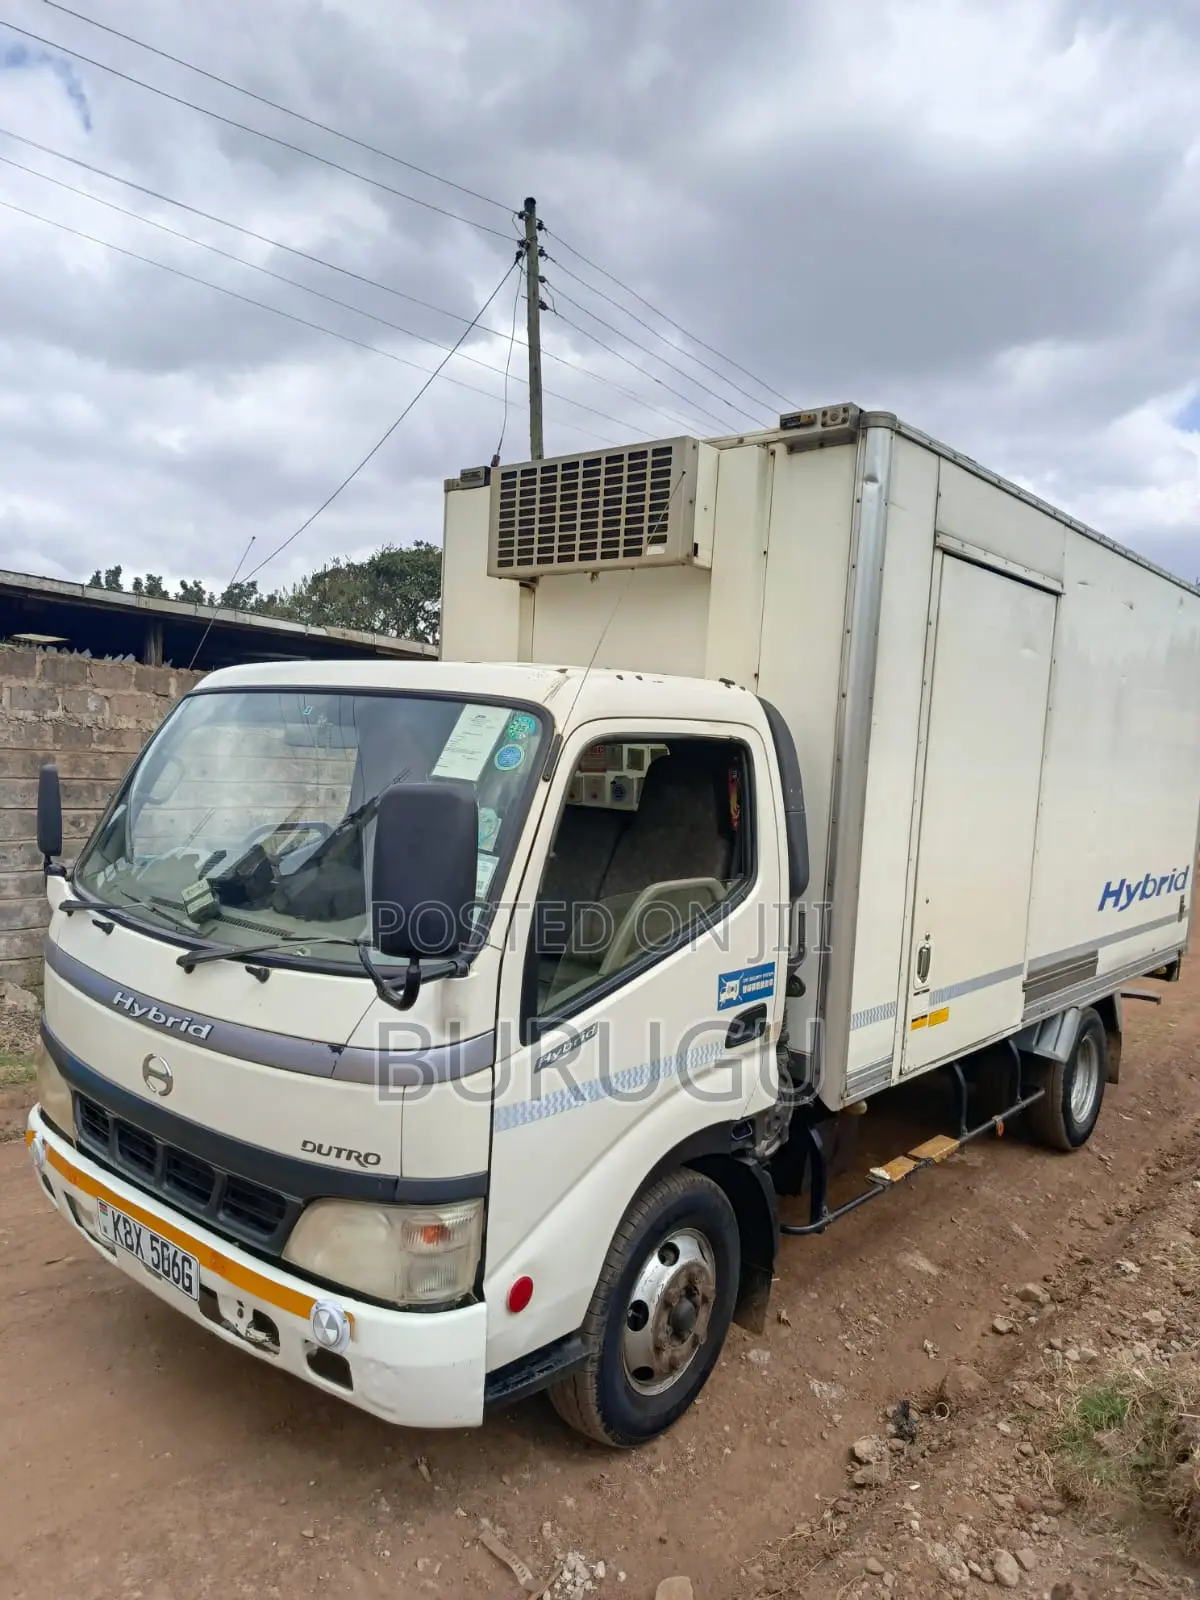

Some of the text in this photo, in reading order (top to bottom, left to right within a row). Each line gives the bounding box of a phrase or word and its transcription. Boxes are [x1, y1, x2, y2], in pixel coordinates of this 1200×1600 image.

[1098, 865, 1190, 912] Hybrid
[113, 992, 213, 1039] Hybrid
[538, 1025, 597, 1069] Hybrid
[301, 1140, 381, 1168] DUTRO
[112, 1210, 144, 1260] KBX
